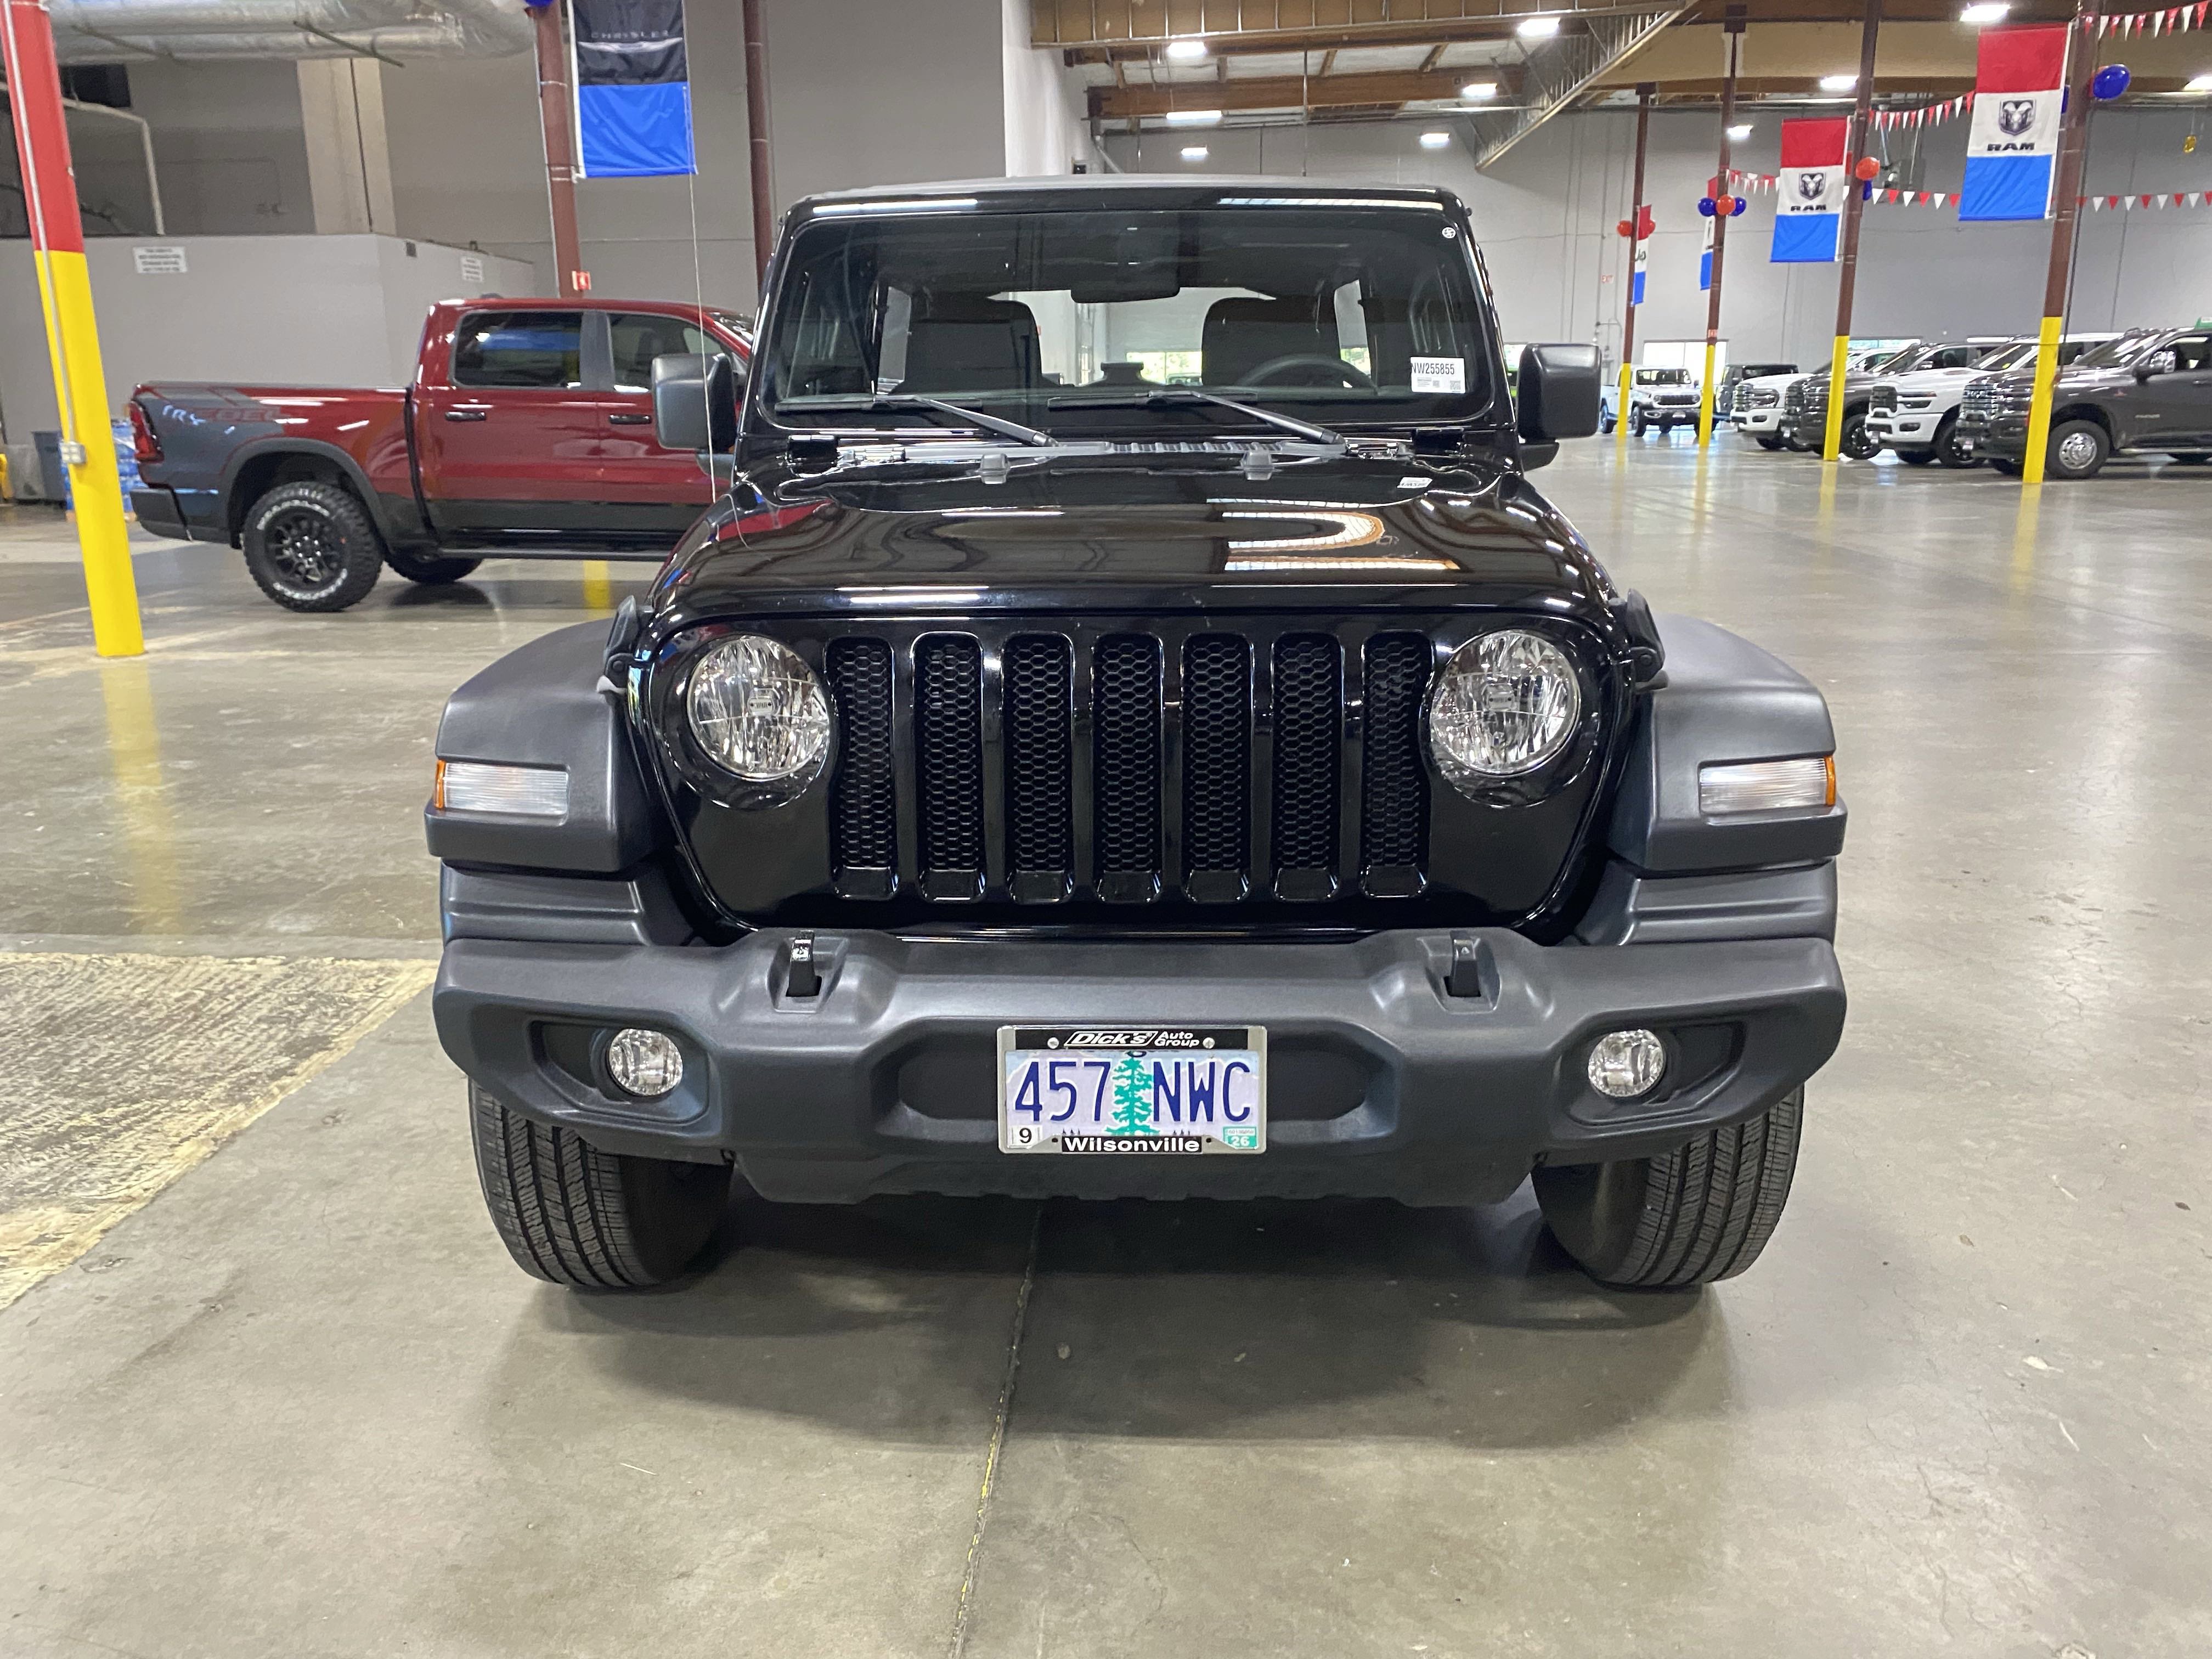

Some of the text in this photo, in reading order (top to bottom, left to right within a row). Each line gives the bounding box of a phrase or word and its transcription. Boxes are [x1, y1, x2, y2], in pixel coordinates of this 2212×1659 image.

[1987, 143, 2035, 151] RAM
[1070, 1032, 1148, 1045] Dick's
[1159, 1031, 1193, 1039] Auto
[1154, 1038, 1200, 1048] Group
[1015, 1061, 1250, 1122] 457 NWC
[1019, 1127, 1032, 1143] 9
[1064, 1137, 1200, 1152] Wilsonville
[1231, 1136, 1250, 1147] 26
